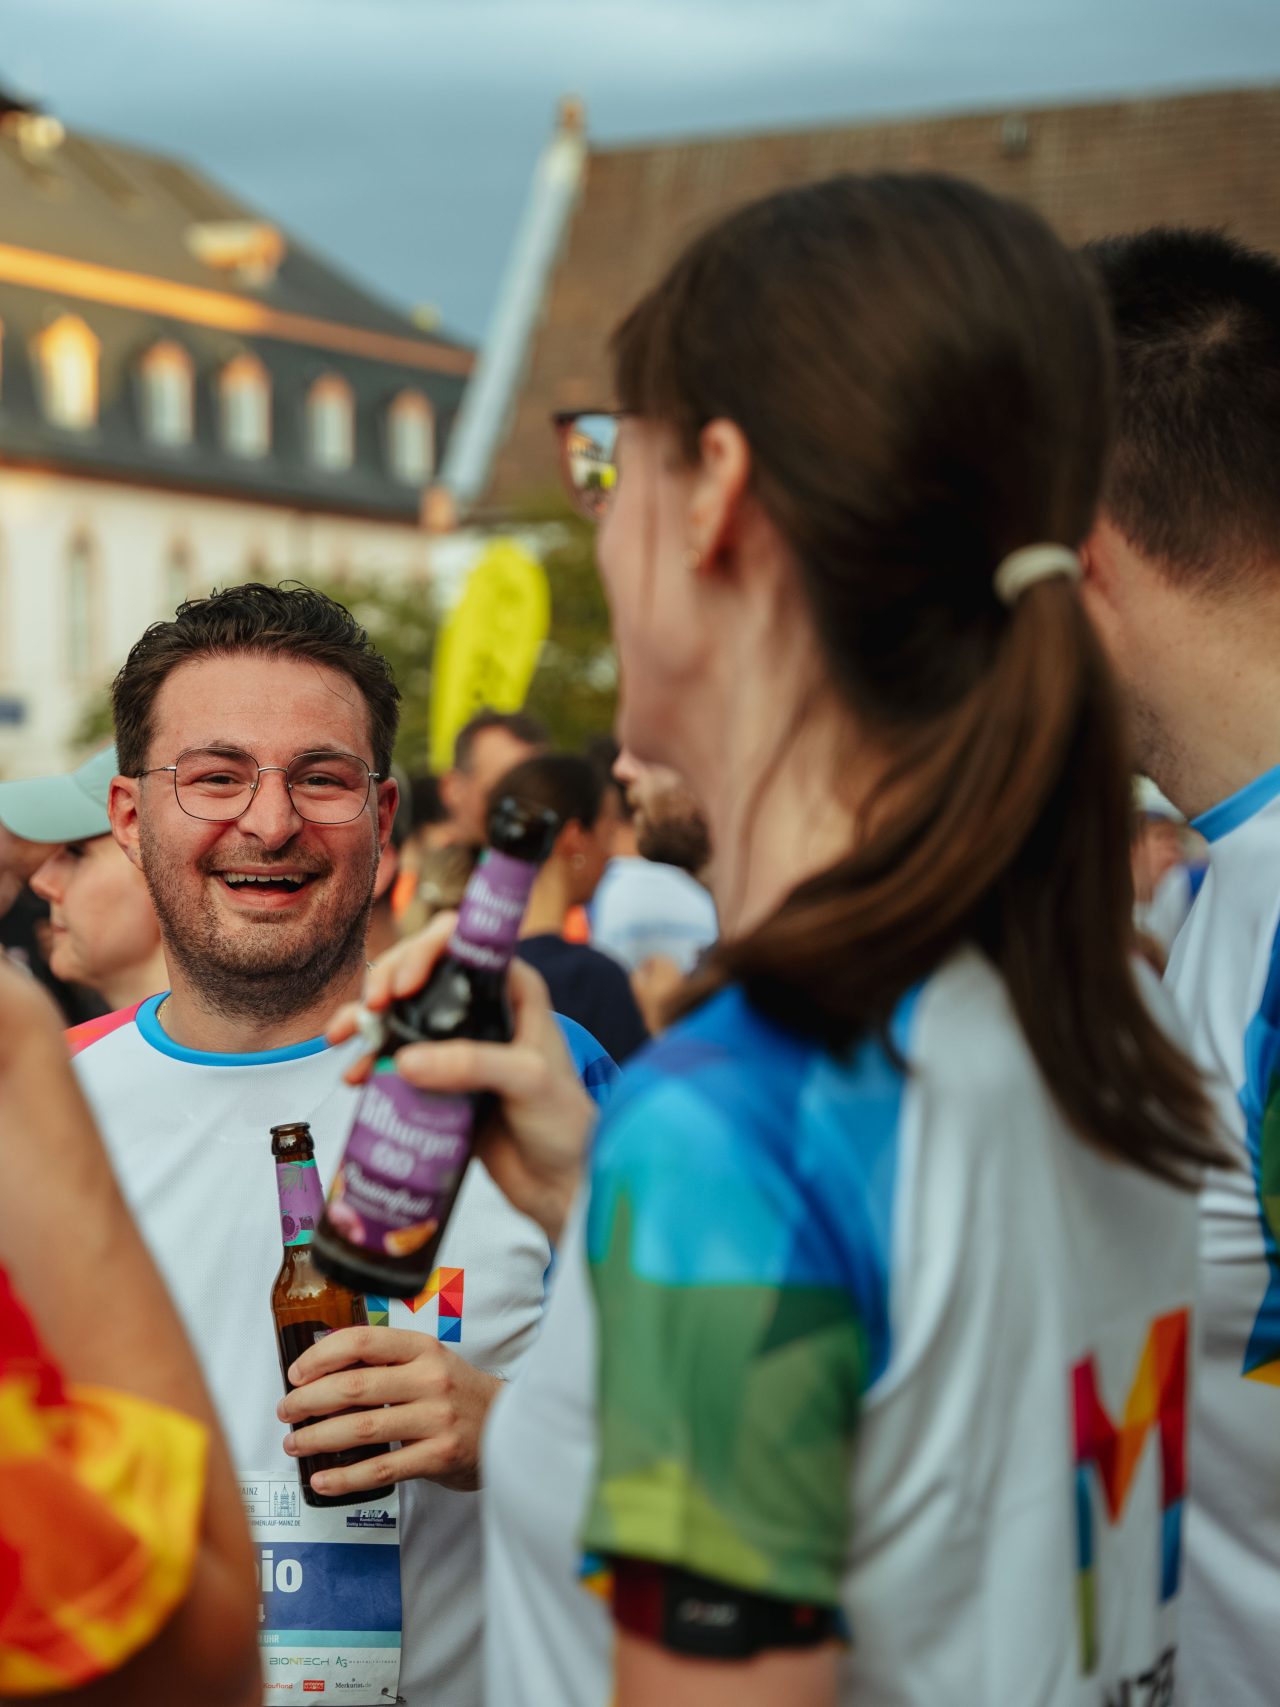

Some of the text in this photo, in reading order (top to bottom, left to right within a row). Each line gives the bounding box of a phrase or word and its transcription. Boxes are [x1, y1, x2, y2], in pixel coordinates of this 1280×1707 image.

[239, 1487, 258, 1496] AINZ
[255, 1549, 303, 1593] io
[269, 1656, 330, 1666] BIONTECH
